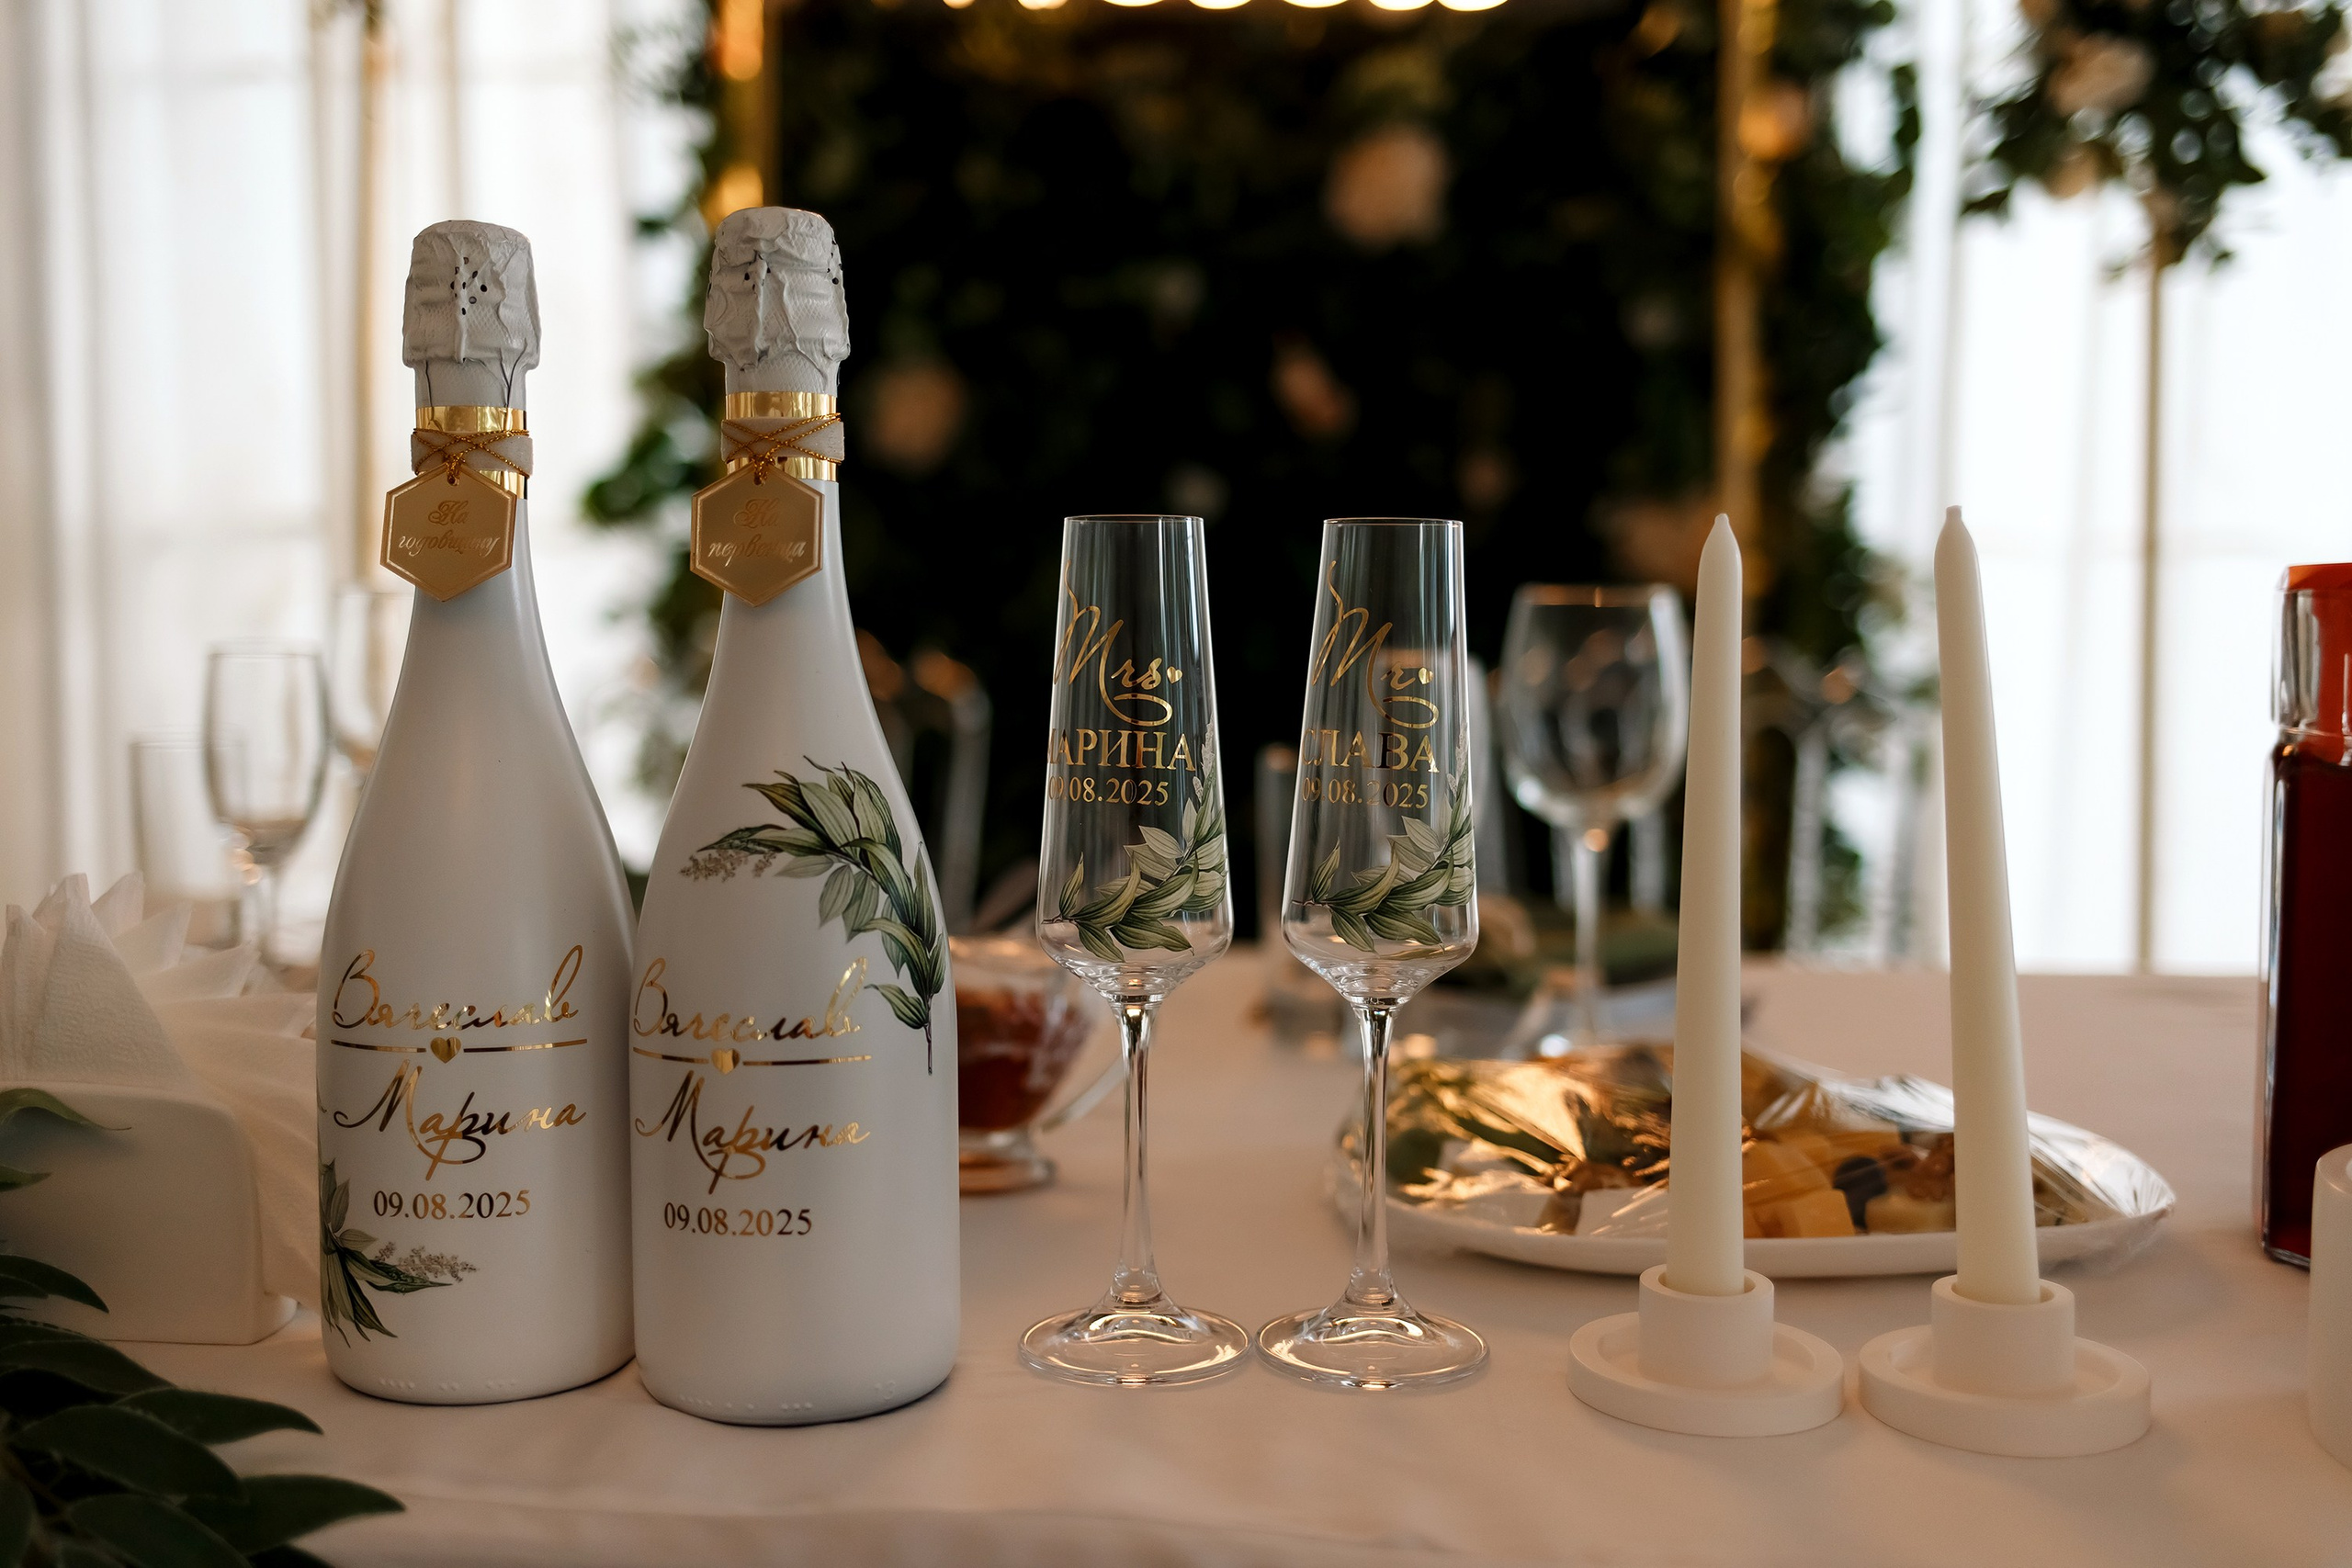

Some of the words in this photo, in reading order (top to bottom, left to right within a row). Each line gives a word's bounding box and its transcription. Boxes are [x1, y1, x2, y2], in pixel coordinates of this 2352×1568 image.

[427, 500, 469, 526] На
[732, 497, 780, 529] На
[1053, 558, 1174, 728] Mrs
[1311, 559, 1440, 729] Mr
[1301, 728, 1441, 773] СЛАВА
[1301, 776, 1430, 810] 09.08.2025
[331, 943, 584, 1032] Вячеслав
[632, 955, 868, 1043] Вячеслав
[333, 1058, 587, 1181] Марина
[634, 1069, 871, 1195] Марина
[373, 1189, 532, 1221] 09.08.2025
[663, 1201, 813, 1236] 09.08.2025
